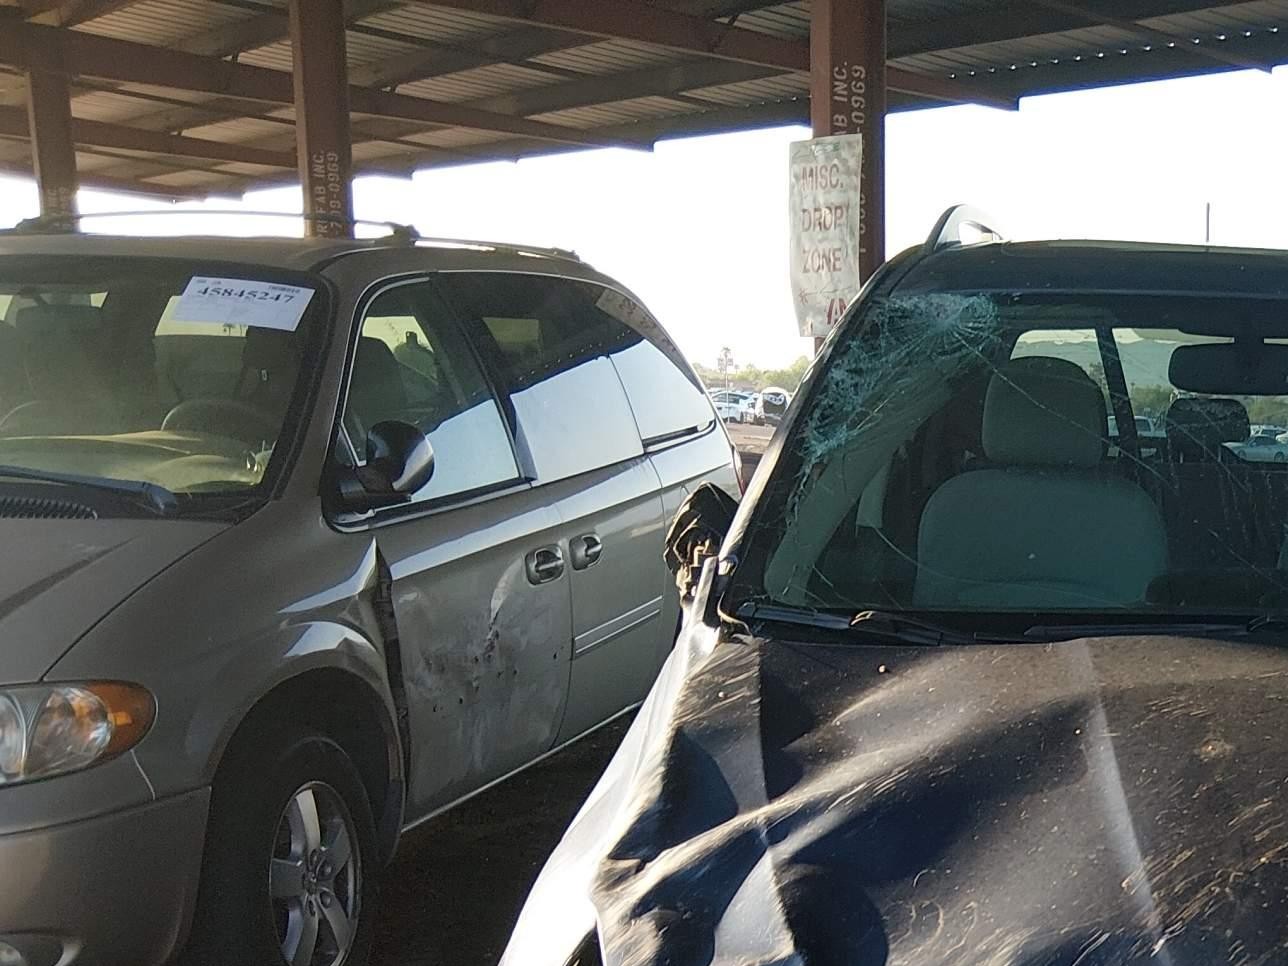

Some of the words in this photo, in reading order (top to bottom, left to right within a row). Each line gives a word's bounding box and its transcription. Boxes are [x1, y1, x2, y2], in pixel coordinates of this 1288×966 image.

[800, 163, 844, 193] MISC.
[802, 247, 843, 274] ZONE
[196, 286, 296, 304] 45845247
